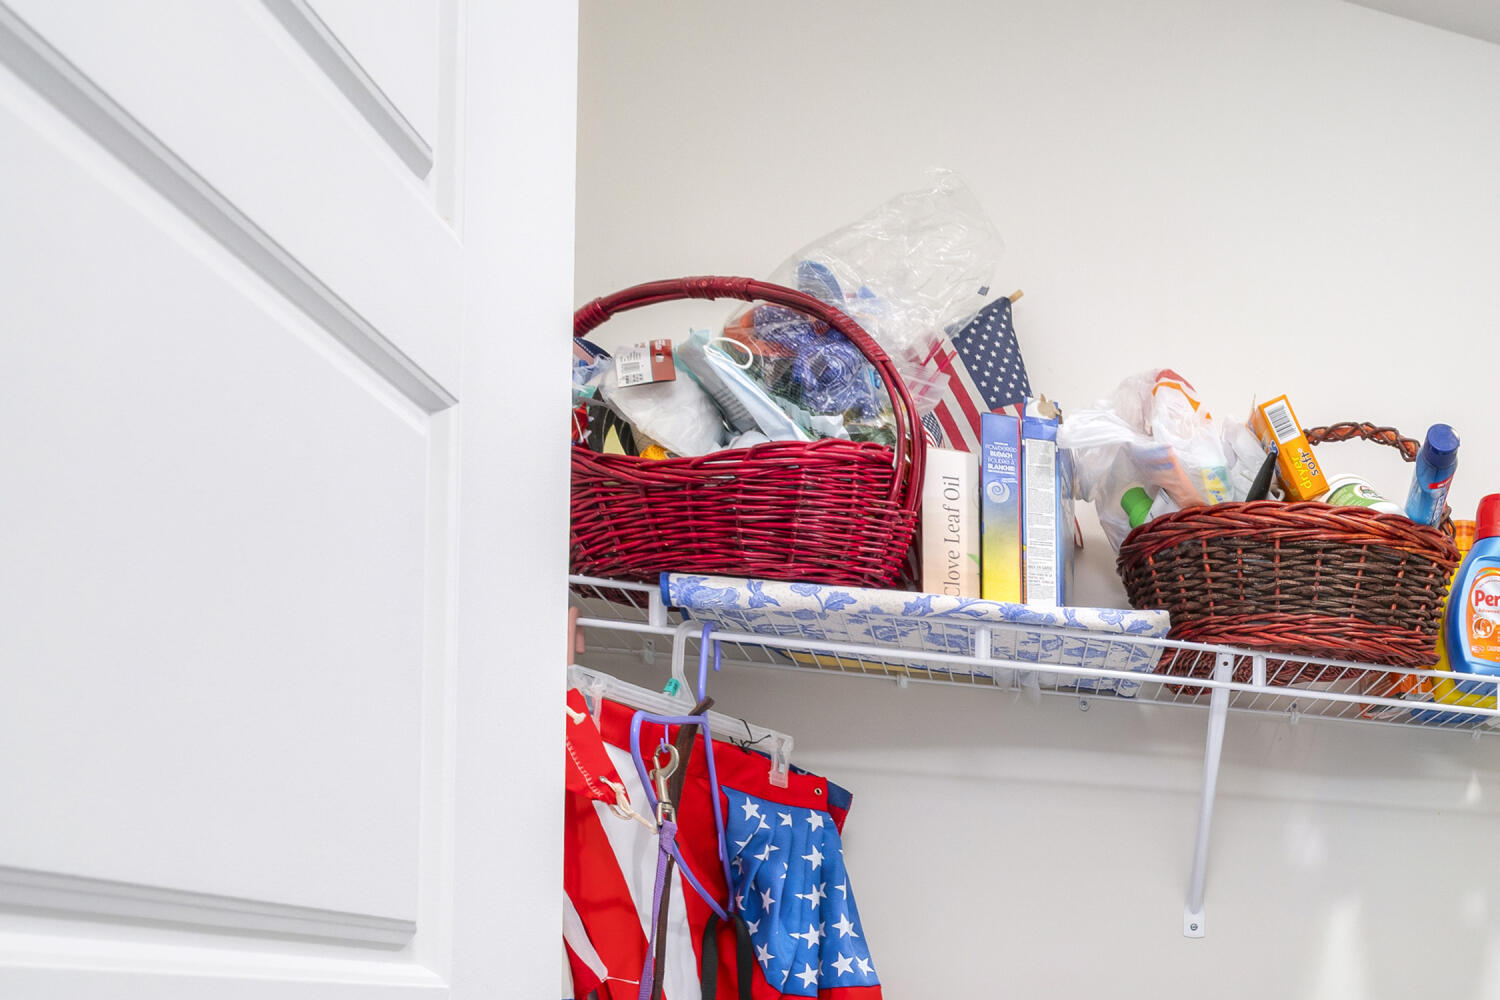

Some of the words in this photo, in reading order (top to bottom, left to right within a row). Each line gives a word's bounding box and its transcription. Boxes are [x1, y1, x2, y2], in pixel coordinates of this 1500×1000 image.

[942, 475, 960, 501] Oil
[942, 503, 960, 544] Leaf
[943, 550, 961, 597] Clove
